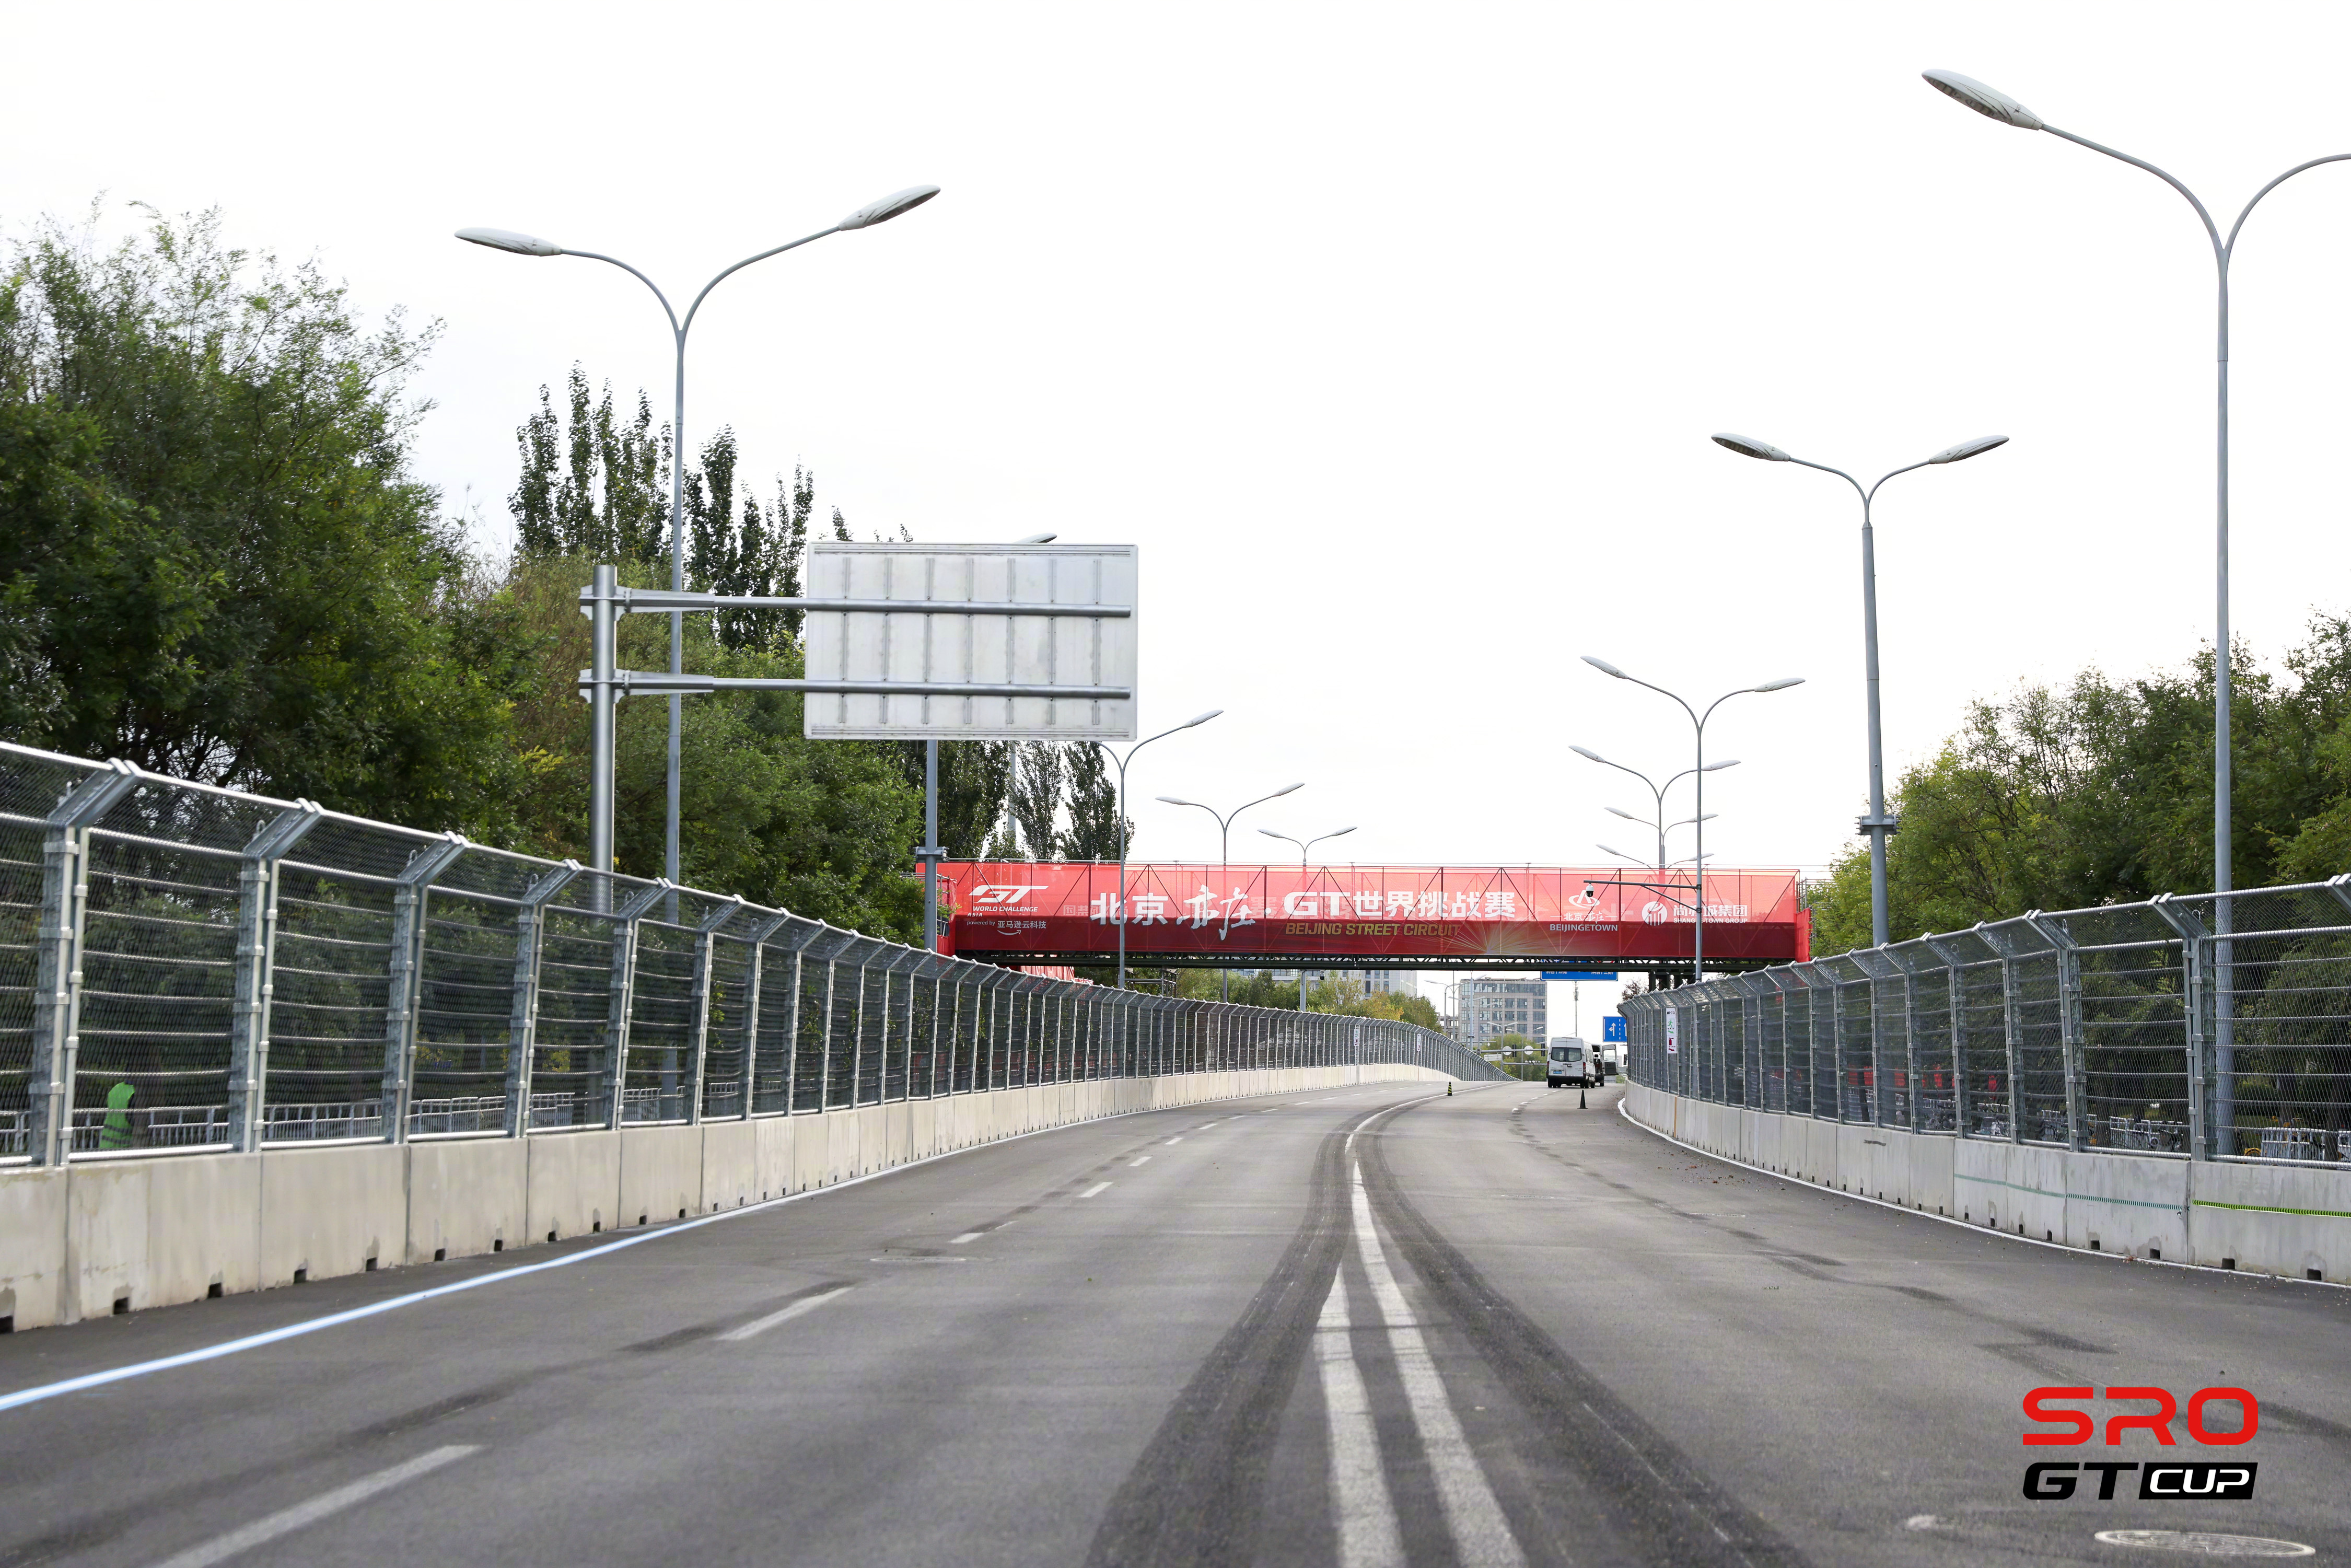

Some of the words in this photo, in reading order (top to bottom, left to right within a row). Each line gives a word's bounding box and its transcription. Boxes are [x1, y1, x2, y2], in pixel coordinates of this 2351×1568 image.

[1285, 923, 1342, 935] BEIJING
[1345, 923, 1401, 935] STREET
[1403, 924, 1461, 936] CIRCUIT
[1550, 924, 1618, 932] BEIJINGETOWN
